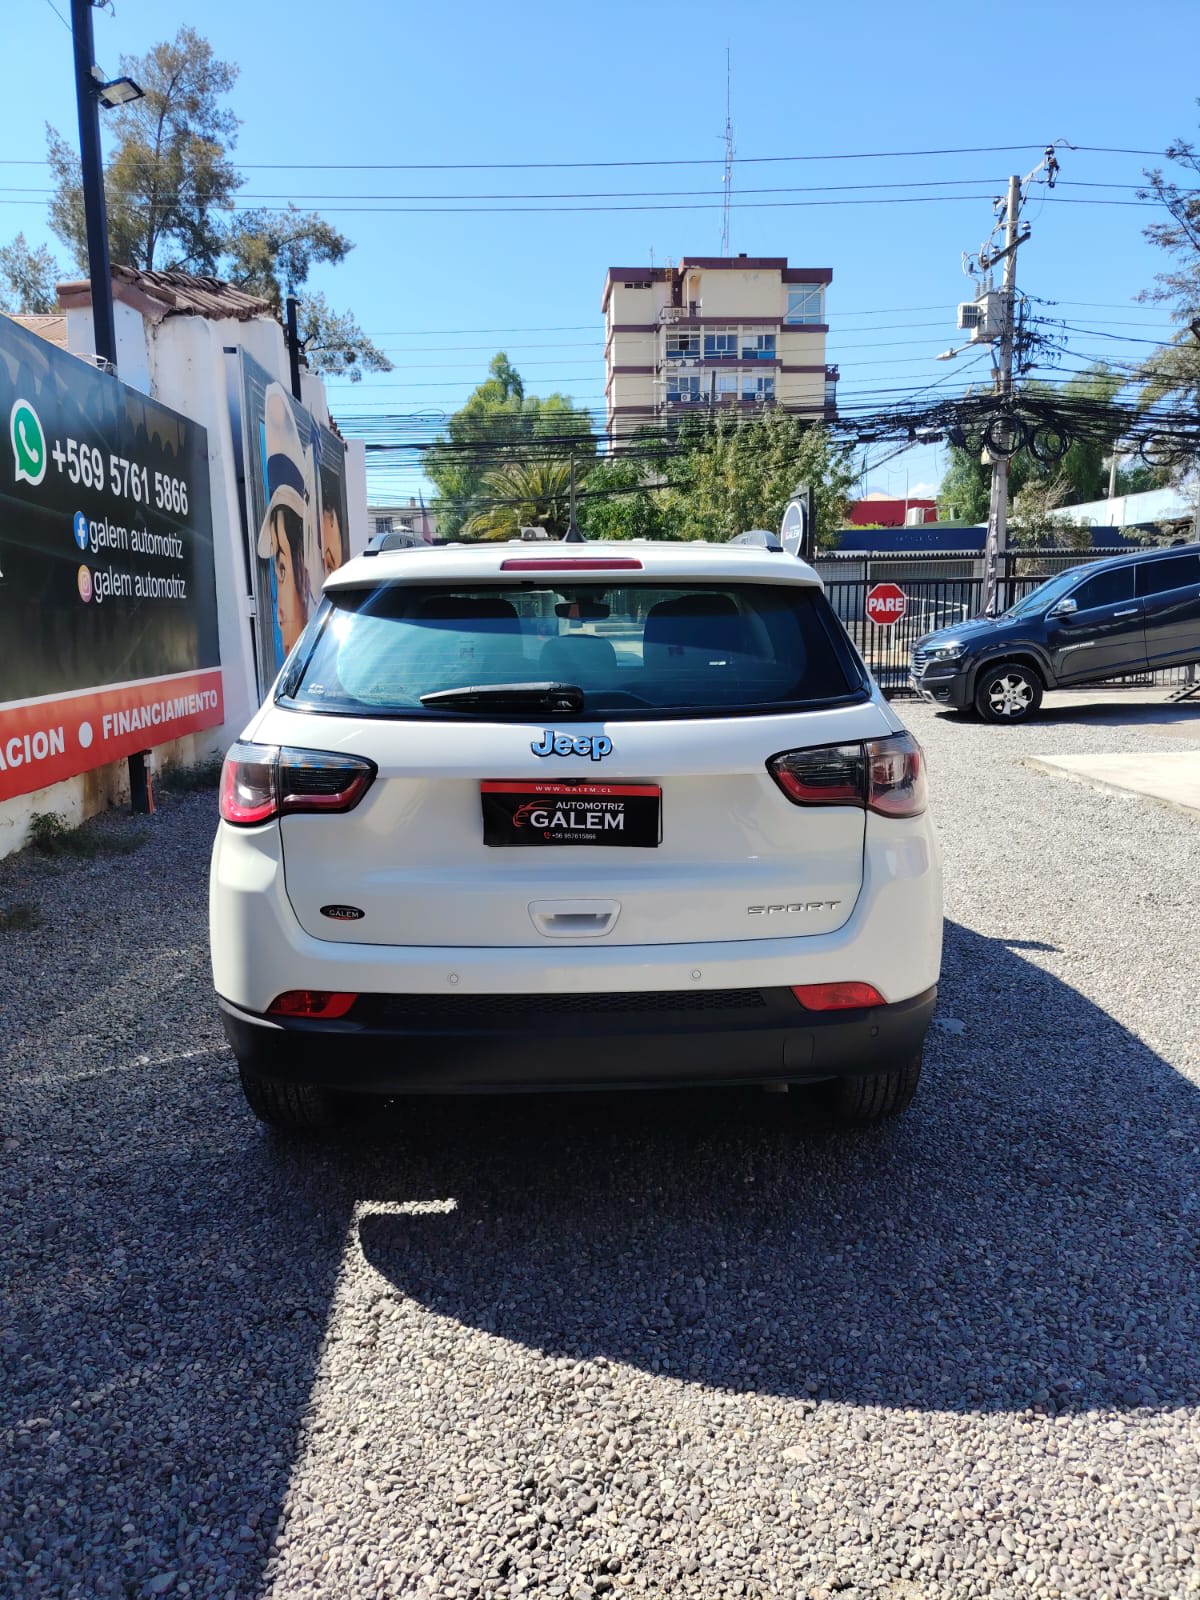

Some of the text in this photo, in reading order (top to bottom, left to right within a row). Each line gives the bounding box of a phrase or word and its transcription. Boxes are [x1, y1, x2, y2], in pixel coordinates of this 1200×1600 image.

[52, 438, 189, 516] +569 5761 5866
[89, 516, 184, 559] galem automotriz
[93, 565, 187, 604] galem automotriz
[868, 597, 904, 612] PARE
[102, 689, 218, 740] FINANCIAMIENTO
[531, 730, 614, 761] Jeep
[555, 801, 625, 811] AUTOMOTRIZ
[530, 810, 625, 830] GALEM
[328, 909, 359, 919] GALEM
[747, 900, 842, 915] SPORT
